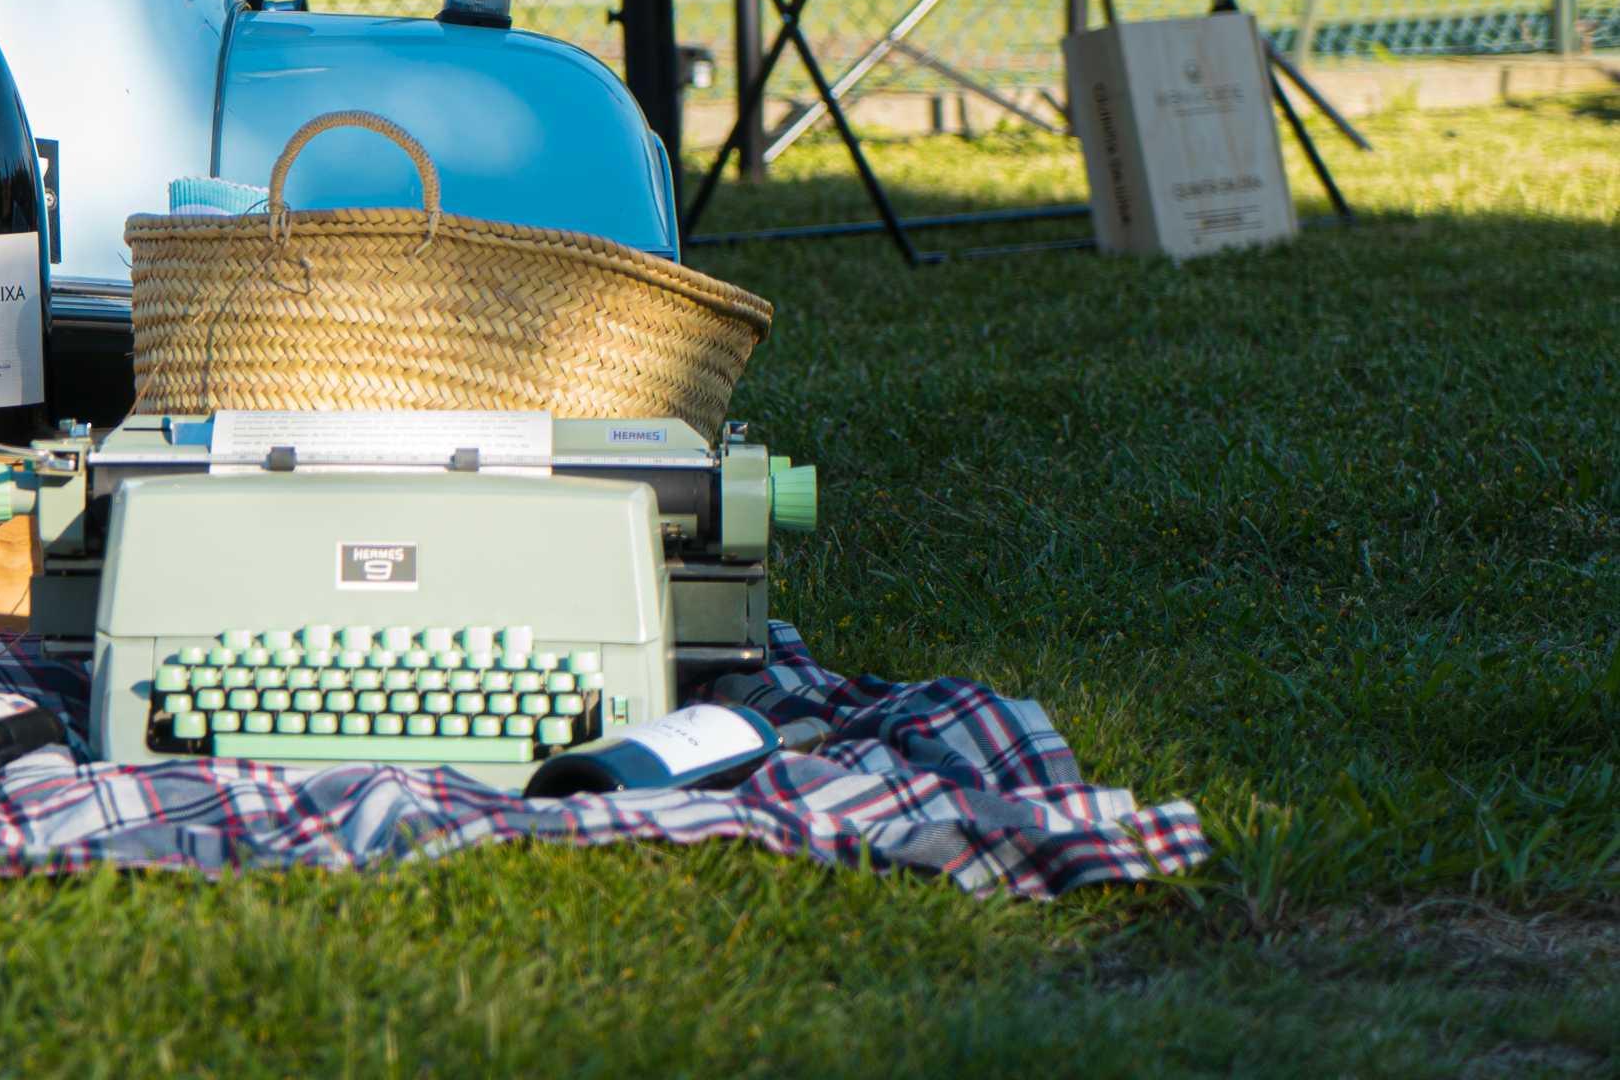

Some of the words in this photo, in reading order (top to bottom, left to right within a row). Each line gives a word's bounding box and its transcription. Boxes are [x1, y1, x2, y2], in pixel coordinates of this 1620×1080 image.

[613, 430, 660, 441] HERMES
[353, 547, 405, 561] HERMES
[364, 560, 393, 580] 9
